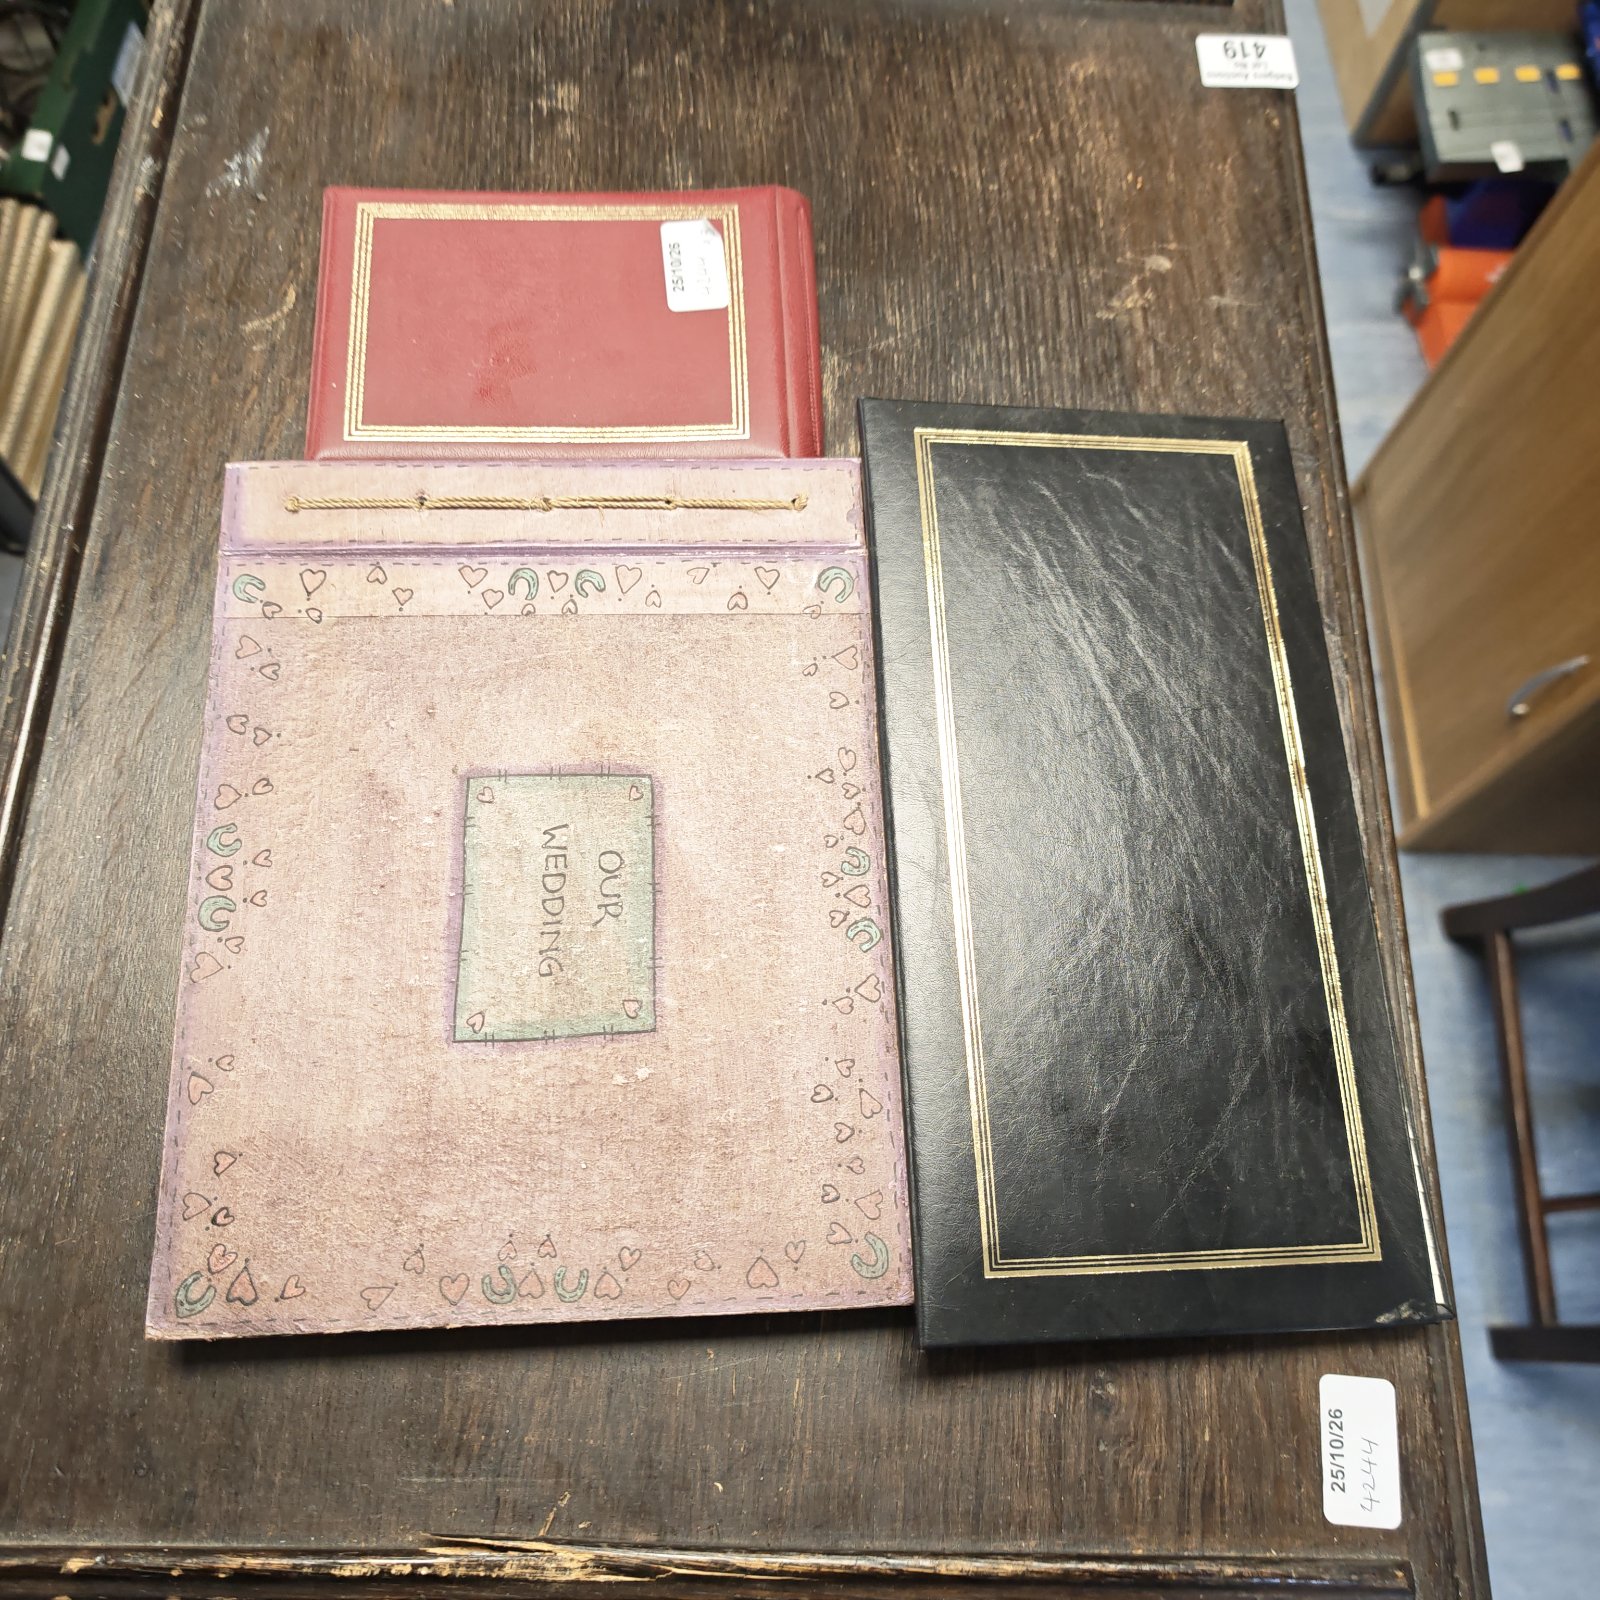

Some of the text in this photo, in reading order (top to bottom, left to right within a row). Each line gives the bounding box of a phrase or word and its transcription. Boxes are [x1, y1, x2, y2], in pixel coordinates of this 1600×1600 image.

[1223, 40, 1267, 60] 419
[538, 823, 570, 978] WEDDING
[592, 850, 626, 927] OUR
[1328, 1408, 1346, 1494] 25/10/26
[1359, 1437, 1381, 1513] 4244
